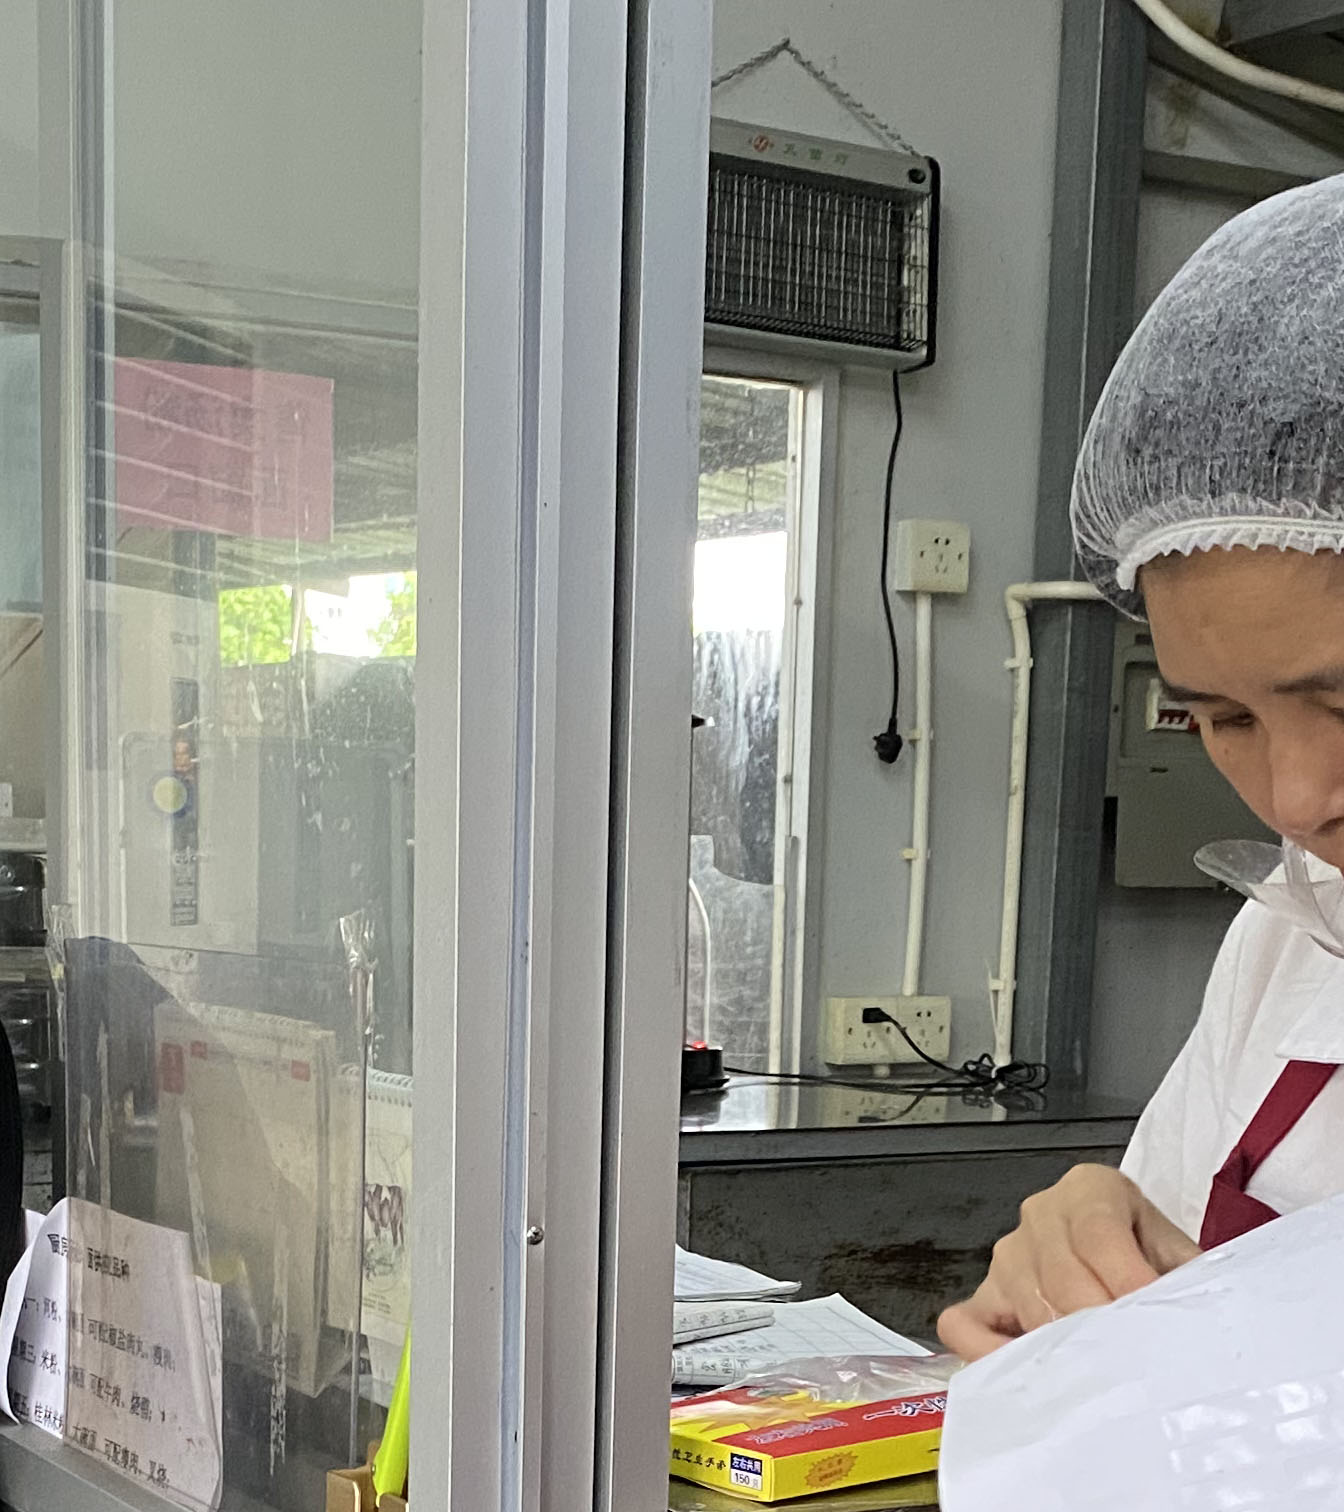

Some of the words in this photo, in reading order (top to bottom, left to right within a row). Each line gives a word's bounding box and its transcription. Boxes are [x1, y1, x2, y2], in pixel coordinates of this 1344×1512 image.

[731, 1456, 761, 1473] 左右共用
[734, 1472, 750, 1485] 150
